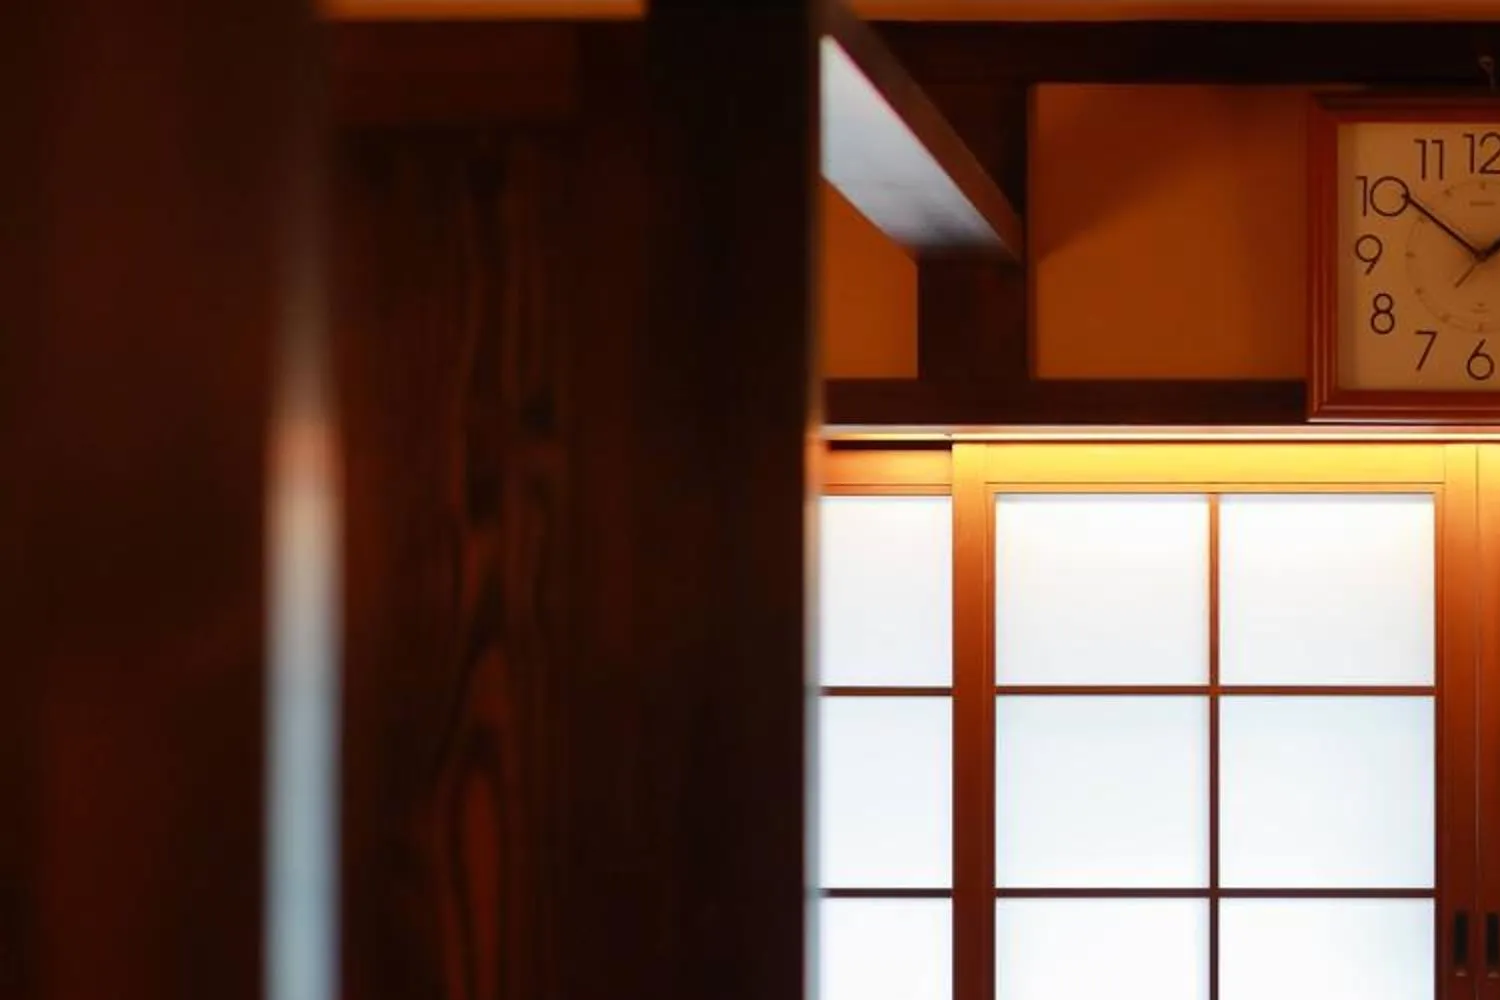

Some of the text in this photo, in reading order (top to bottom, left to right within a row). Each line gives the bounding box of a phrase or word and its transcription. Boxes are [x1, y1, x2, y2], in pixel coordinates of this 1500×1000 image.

[1413, 138, 1445, 181] 11
[1355, 175, 1410, 218] 10
[1353, 233, 1383, 276] 9
[1370, 292, 1396, 335] 8
[1415, 329, 1438, 371] 7
[1466, 339, 1495, 381] 6
